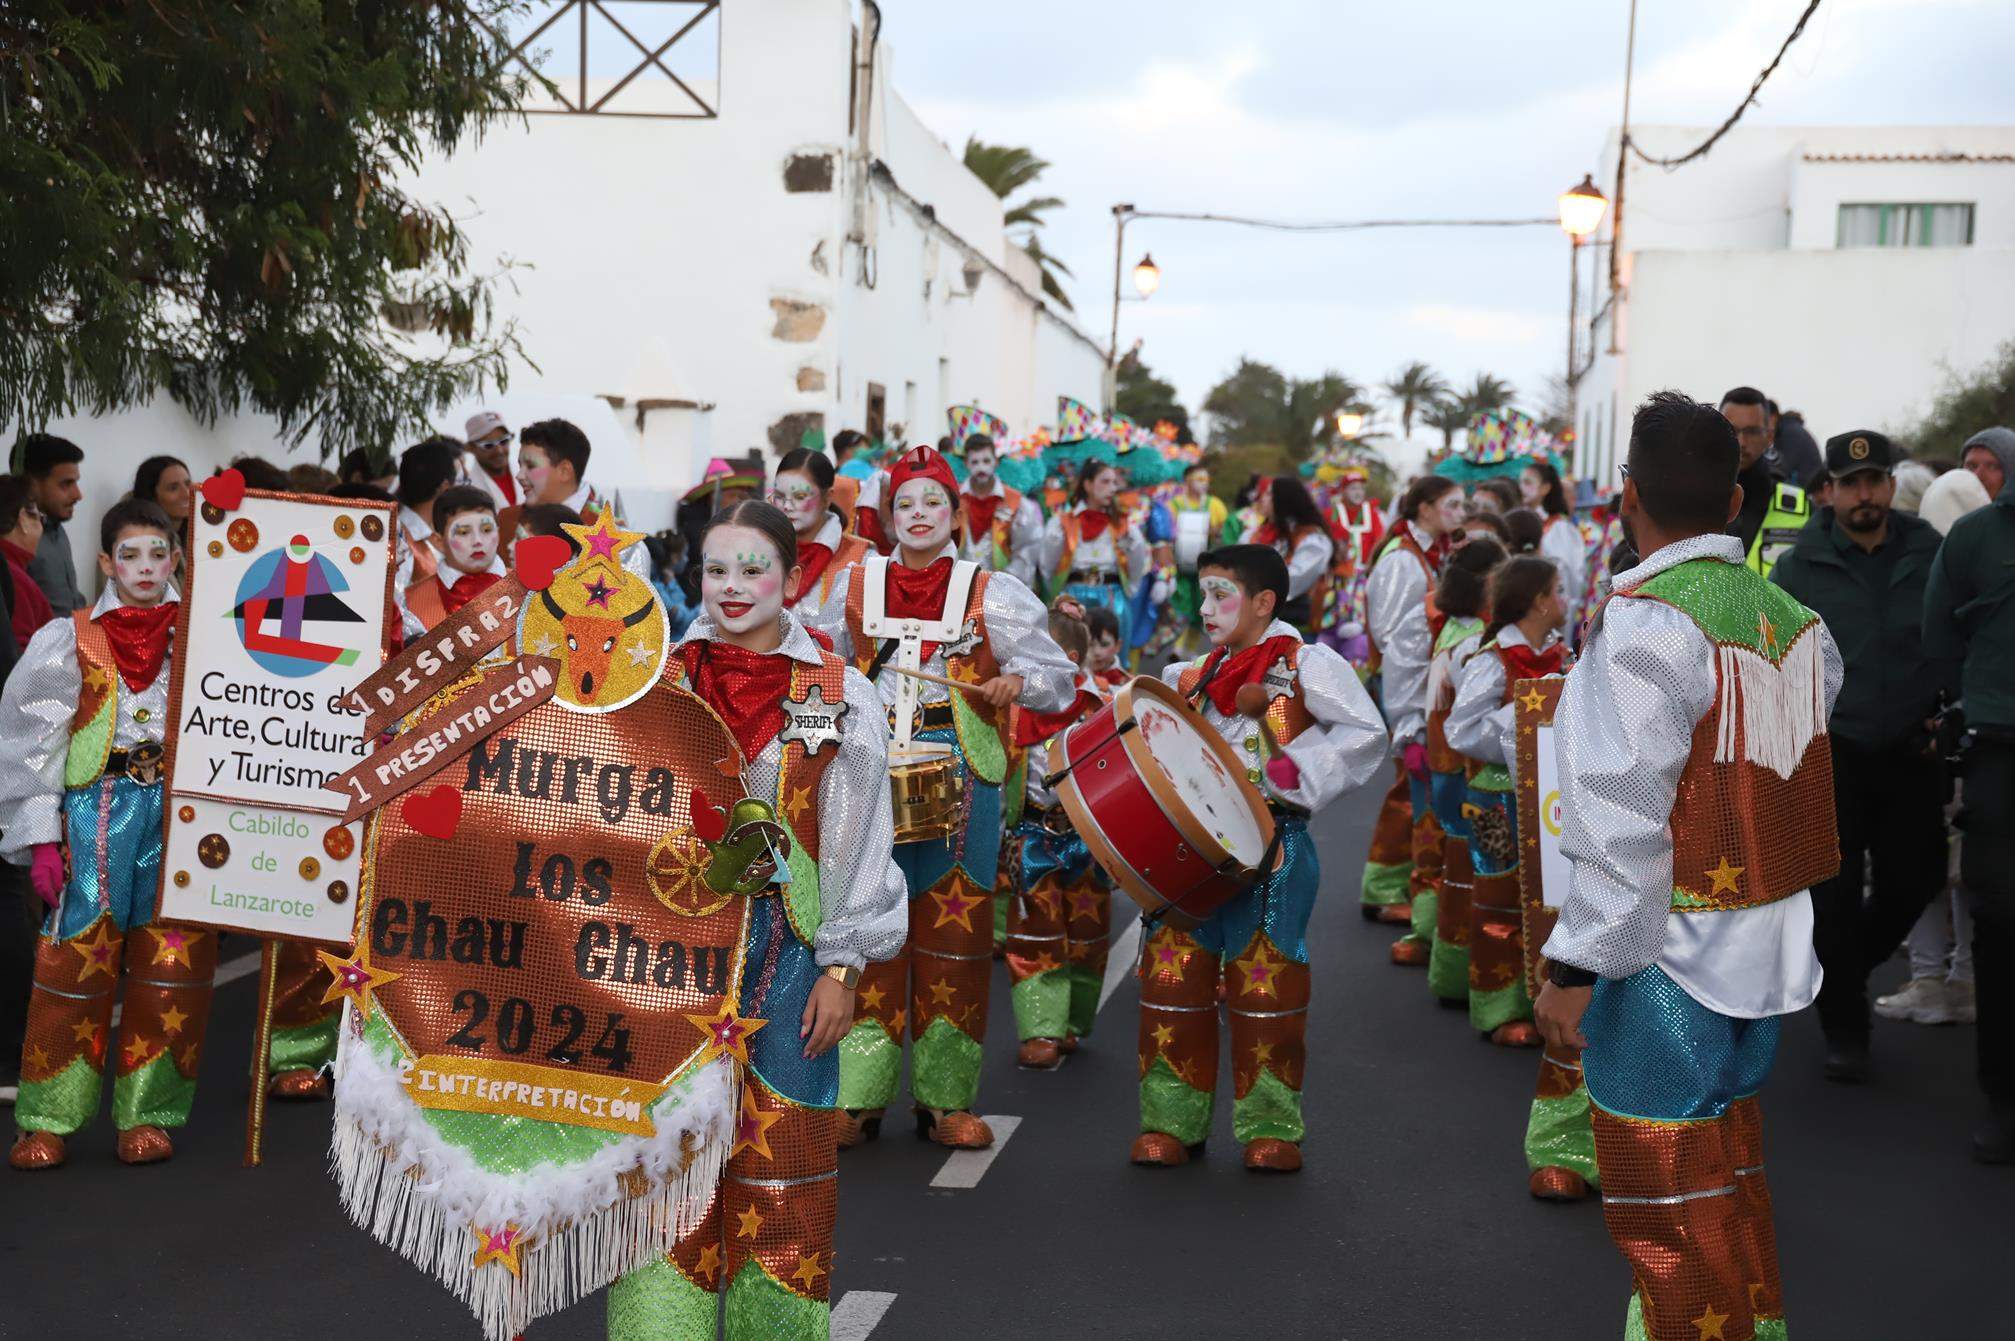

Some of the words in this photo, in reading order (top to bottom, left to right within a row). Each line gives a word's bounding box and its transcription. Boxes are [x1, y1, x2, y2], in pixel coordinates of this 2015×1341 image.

[351, 692, 376, 718] 1
[376, 595, 520, 706] DISFRAZ
[200, 671, 314, 712] Centros
[184, 706, 255, 745] Arte,
[260, 716, 366, 756] Cultura
[348, 776, 372, 804] 1
[375, 662, 553, 786] PRESENTACIÓN
[794, 715, 833, 729] SHERIFF
[207, 757, 225, 786] y
[463, 737, 674, 823] Murga
[228, 811, 310, 839] Cabildo
[251, 851, 278, 873] de
[210, 885, 314, 918] Lanzarote
[373, 898, 530, 969] Chau
[574, 921, 734, 995] Chau
[446, 989, 633, 1072] 2024
[417, 1069, 641, 1122] INTERPRETACIÓN
